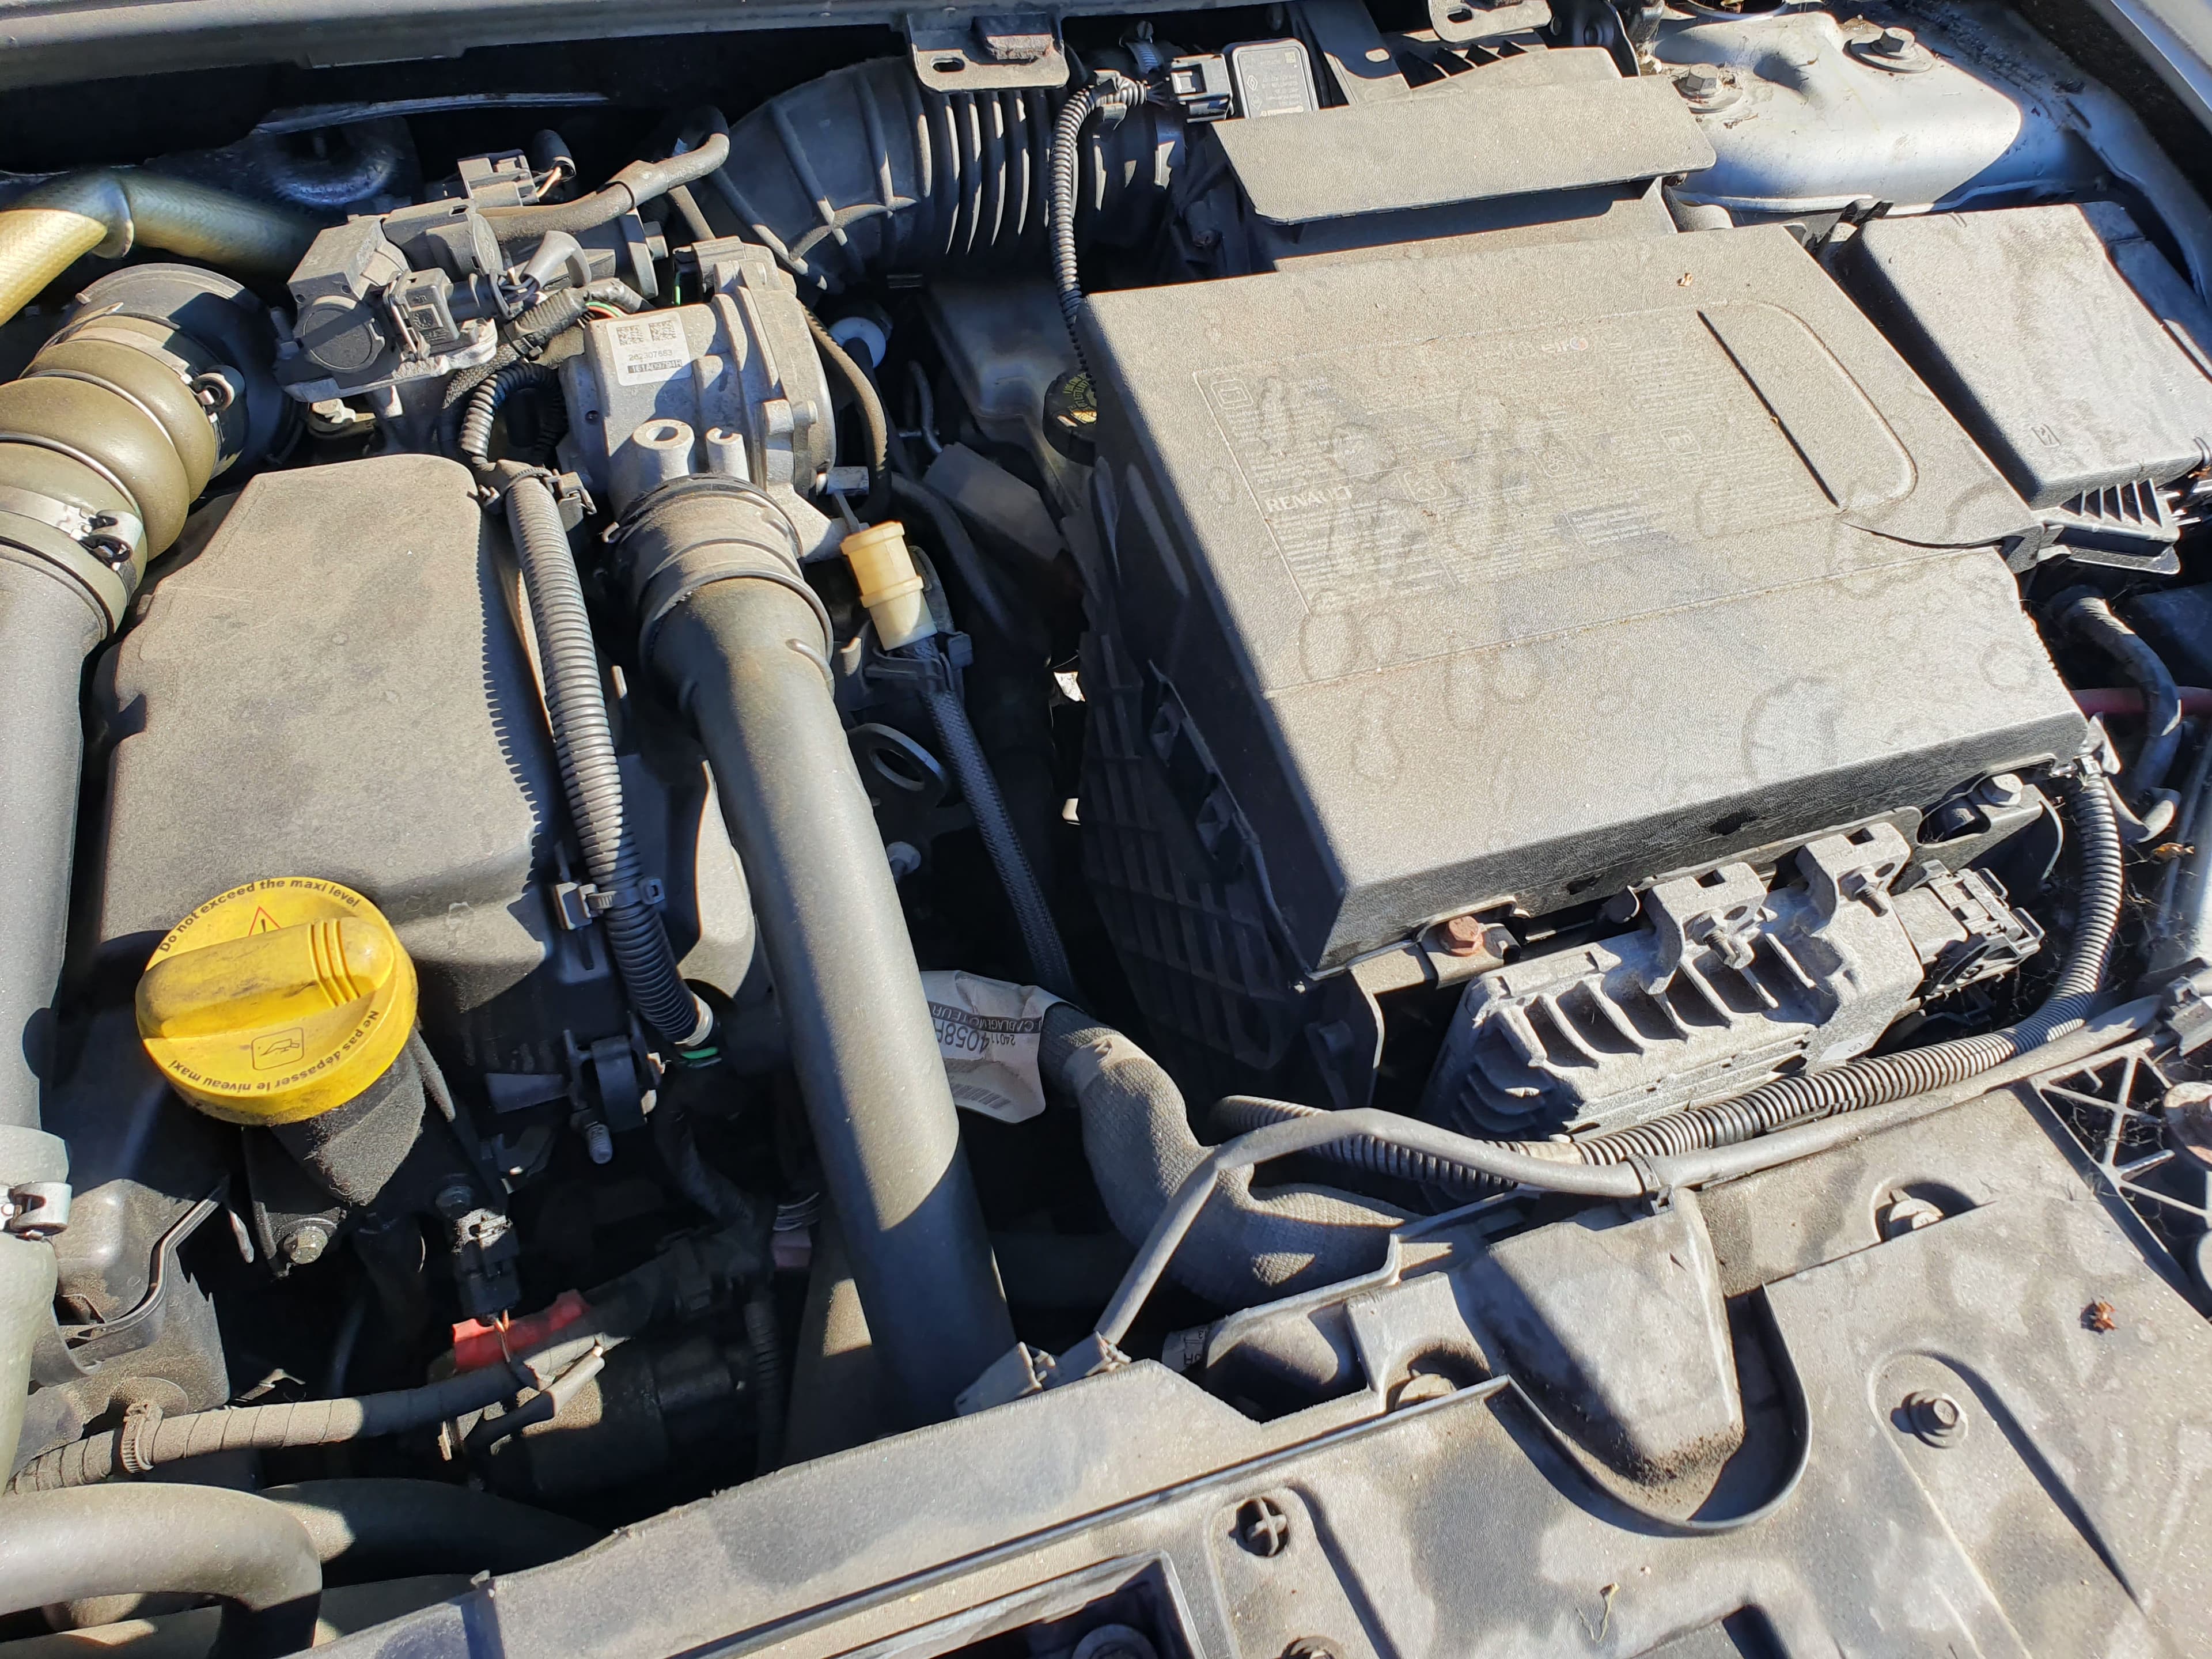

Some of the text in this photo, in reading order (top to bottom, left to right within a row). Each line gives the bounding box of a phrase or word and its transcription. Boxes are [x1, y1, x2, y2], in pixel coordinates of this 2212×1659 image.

[1265, 485, 1353, 513] RENAULT
[159, 879, 361, 952] Do not exceed the maxi level
[362, 1010, 380, 1028] Ne
[342, 1029, 365, 1051] pas
[168, 1059, 202, 1082] maxi
[202, 1077, 252, 1093] niveau
[256, 1082, 271, 1092] le
